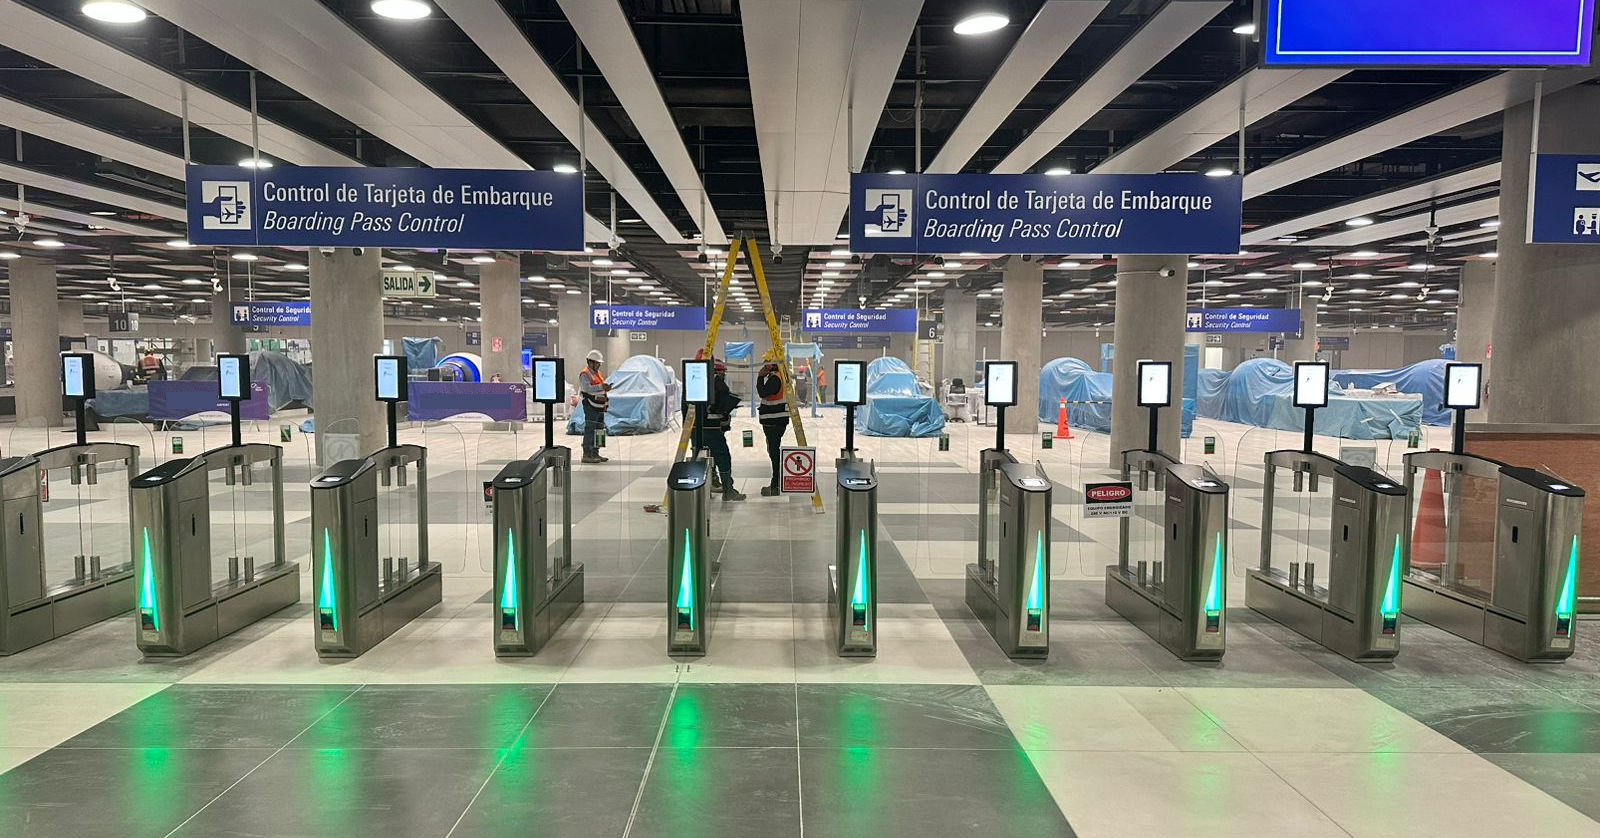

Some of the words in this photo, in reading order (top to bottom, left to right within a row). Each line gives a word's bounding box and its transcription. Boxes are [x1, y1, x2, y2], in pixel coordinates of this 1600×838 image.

[263, 182, 330, 203] Control
[336, 183, 358, 203] de
[364, 184, 426, 208] Tarjeta
[433, 185, 454, 205] de
[461, 186, 553, 211] Embarque
[925, 189, 990, 210] Control
[997, 190, 1019, 210] de
[1024, 190, 1086, 215] Tarjeta
[1092, 190, 1114, 210] de
[1120, 190, 1212, 215] Embarque
[263, 211, 345, 235] Boarding
[350, 211, 393, 232] Pass
[398, 212, 465, 233] Control
[923, 218, 1005, 242] Boarding
[1008, 218, 1052, 238] Pass
[1056, 218, 1124, 239] Control
[383, 277, 414, 290] SALIDA
[252, 315, 277, 323] Security
[644, 310, 675, 318] Seguridad
[856, 313, 887, 321] Seguridad
[1238, 313, 1270, 321] Seguridad
[114, 320, 126, 331] 10
[824, 321, 847, 329] Security
[1204, 321, 1229, 329] Security
[928, 327, 936, 338] 6
